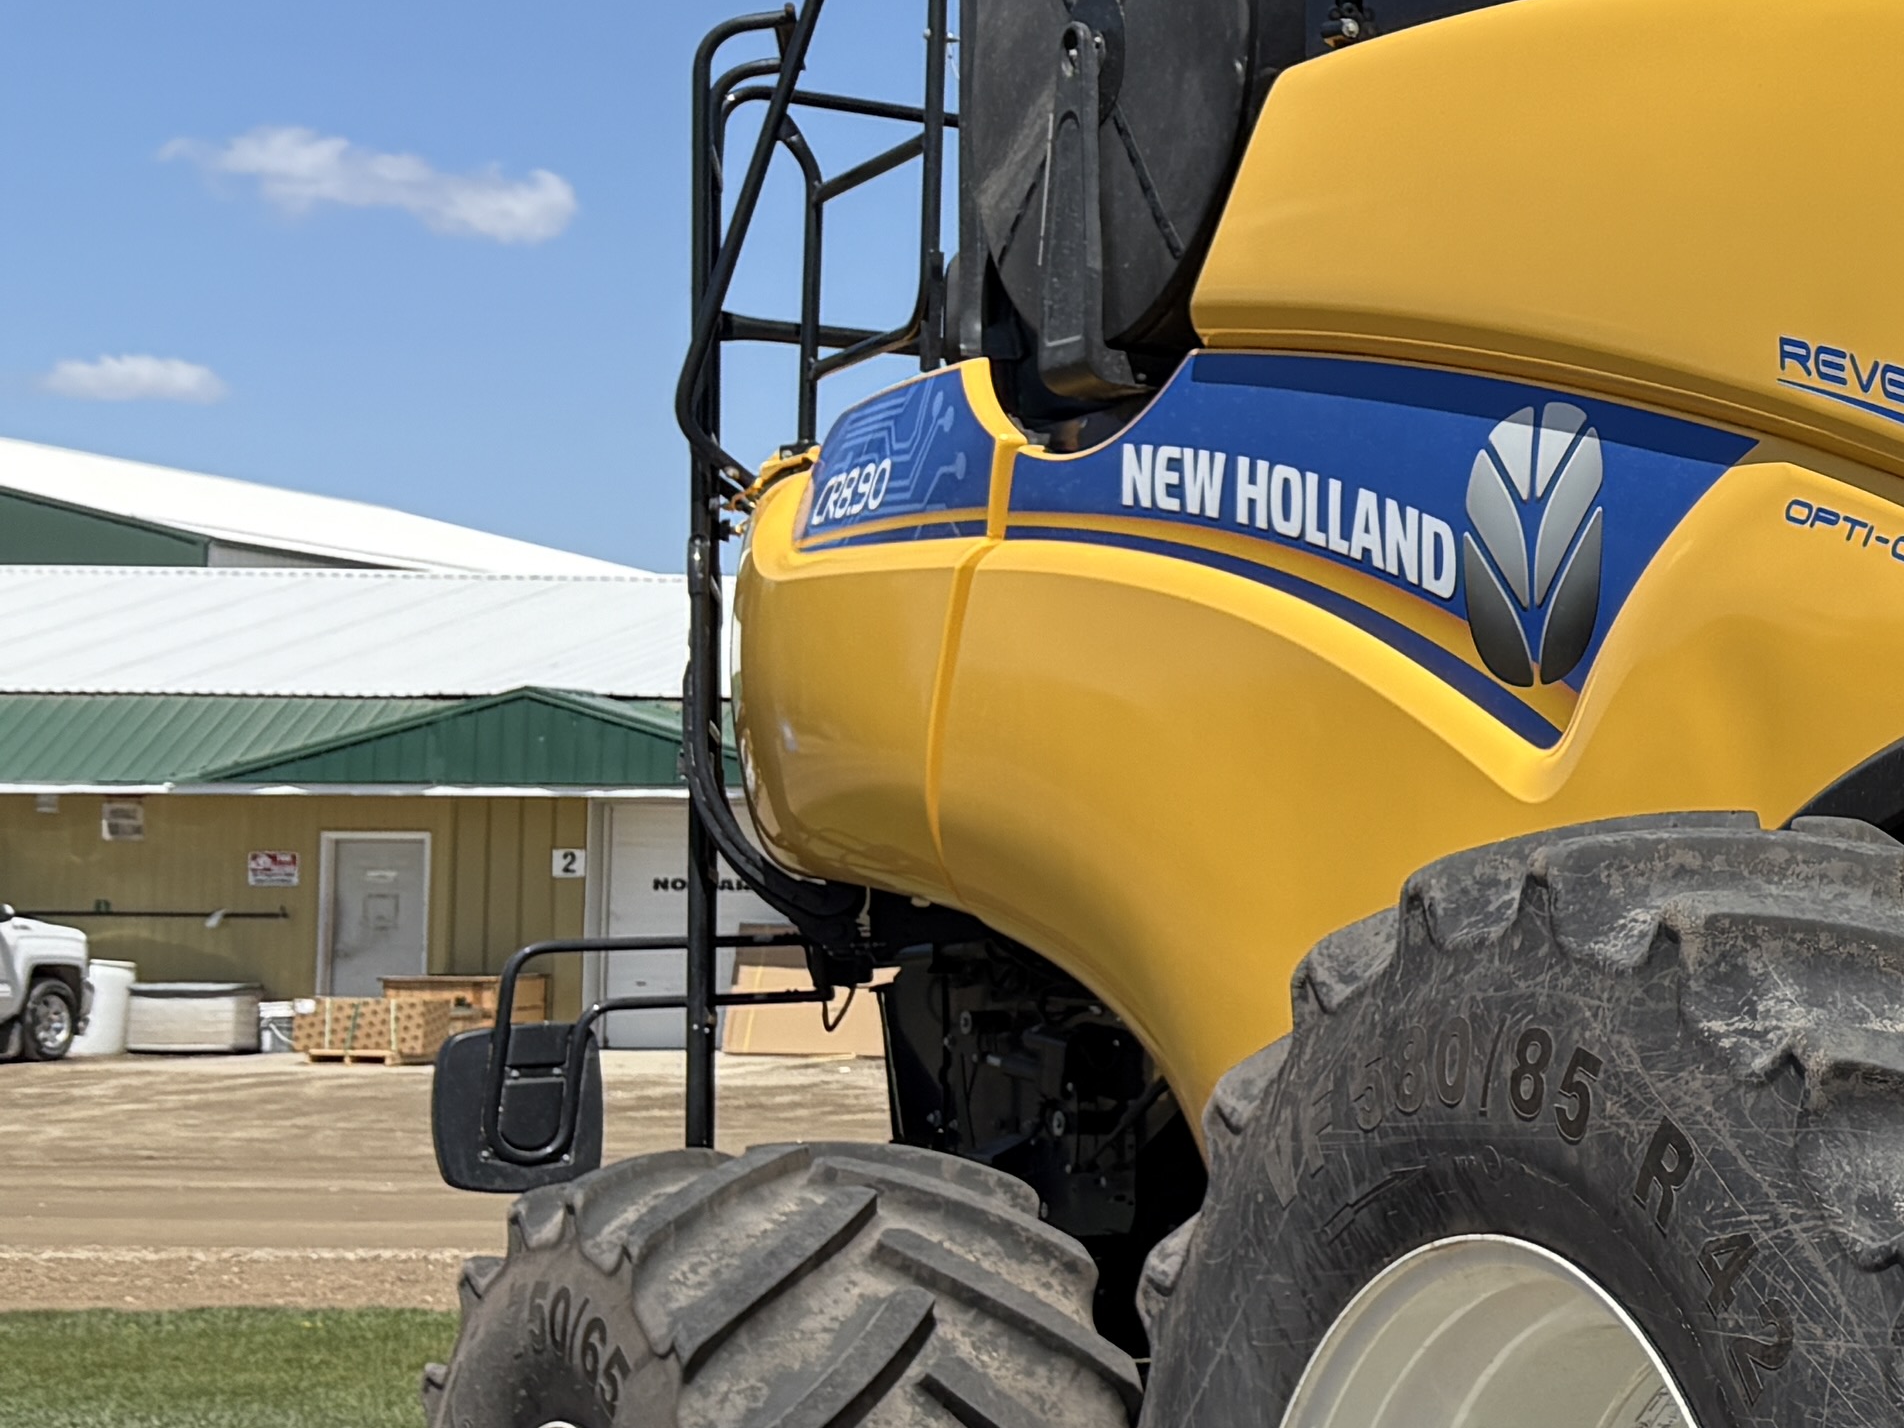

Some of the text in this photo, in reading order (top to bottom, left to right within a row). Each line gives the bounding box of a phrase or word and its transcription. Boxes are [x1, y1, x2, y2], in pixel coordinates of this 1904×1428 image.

[811, 458, 892, 526] CR8.90
[1122, 442, 1457, 600] NEW HOLLAND
[562, 851, 577, 873] 2
[653, 878, 687, 892] NO
